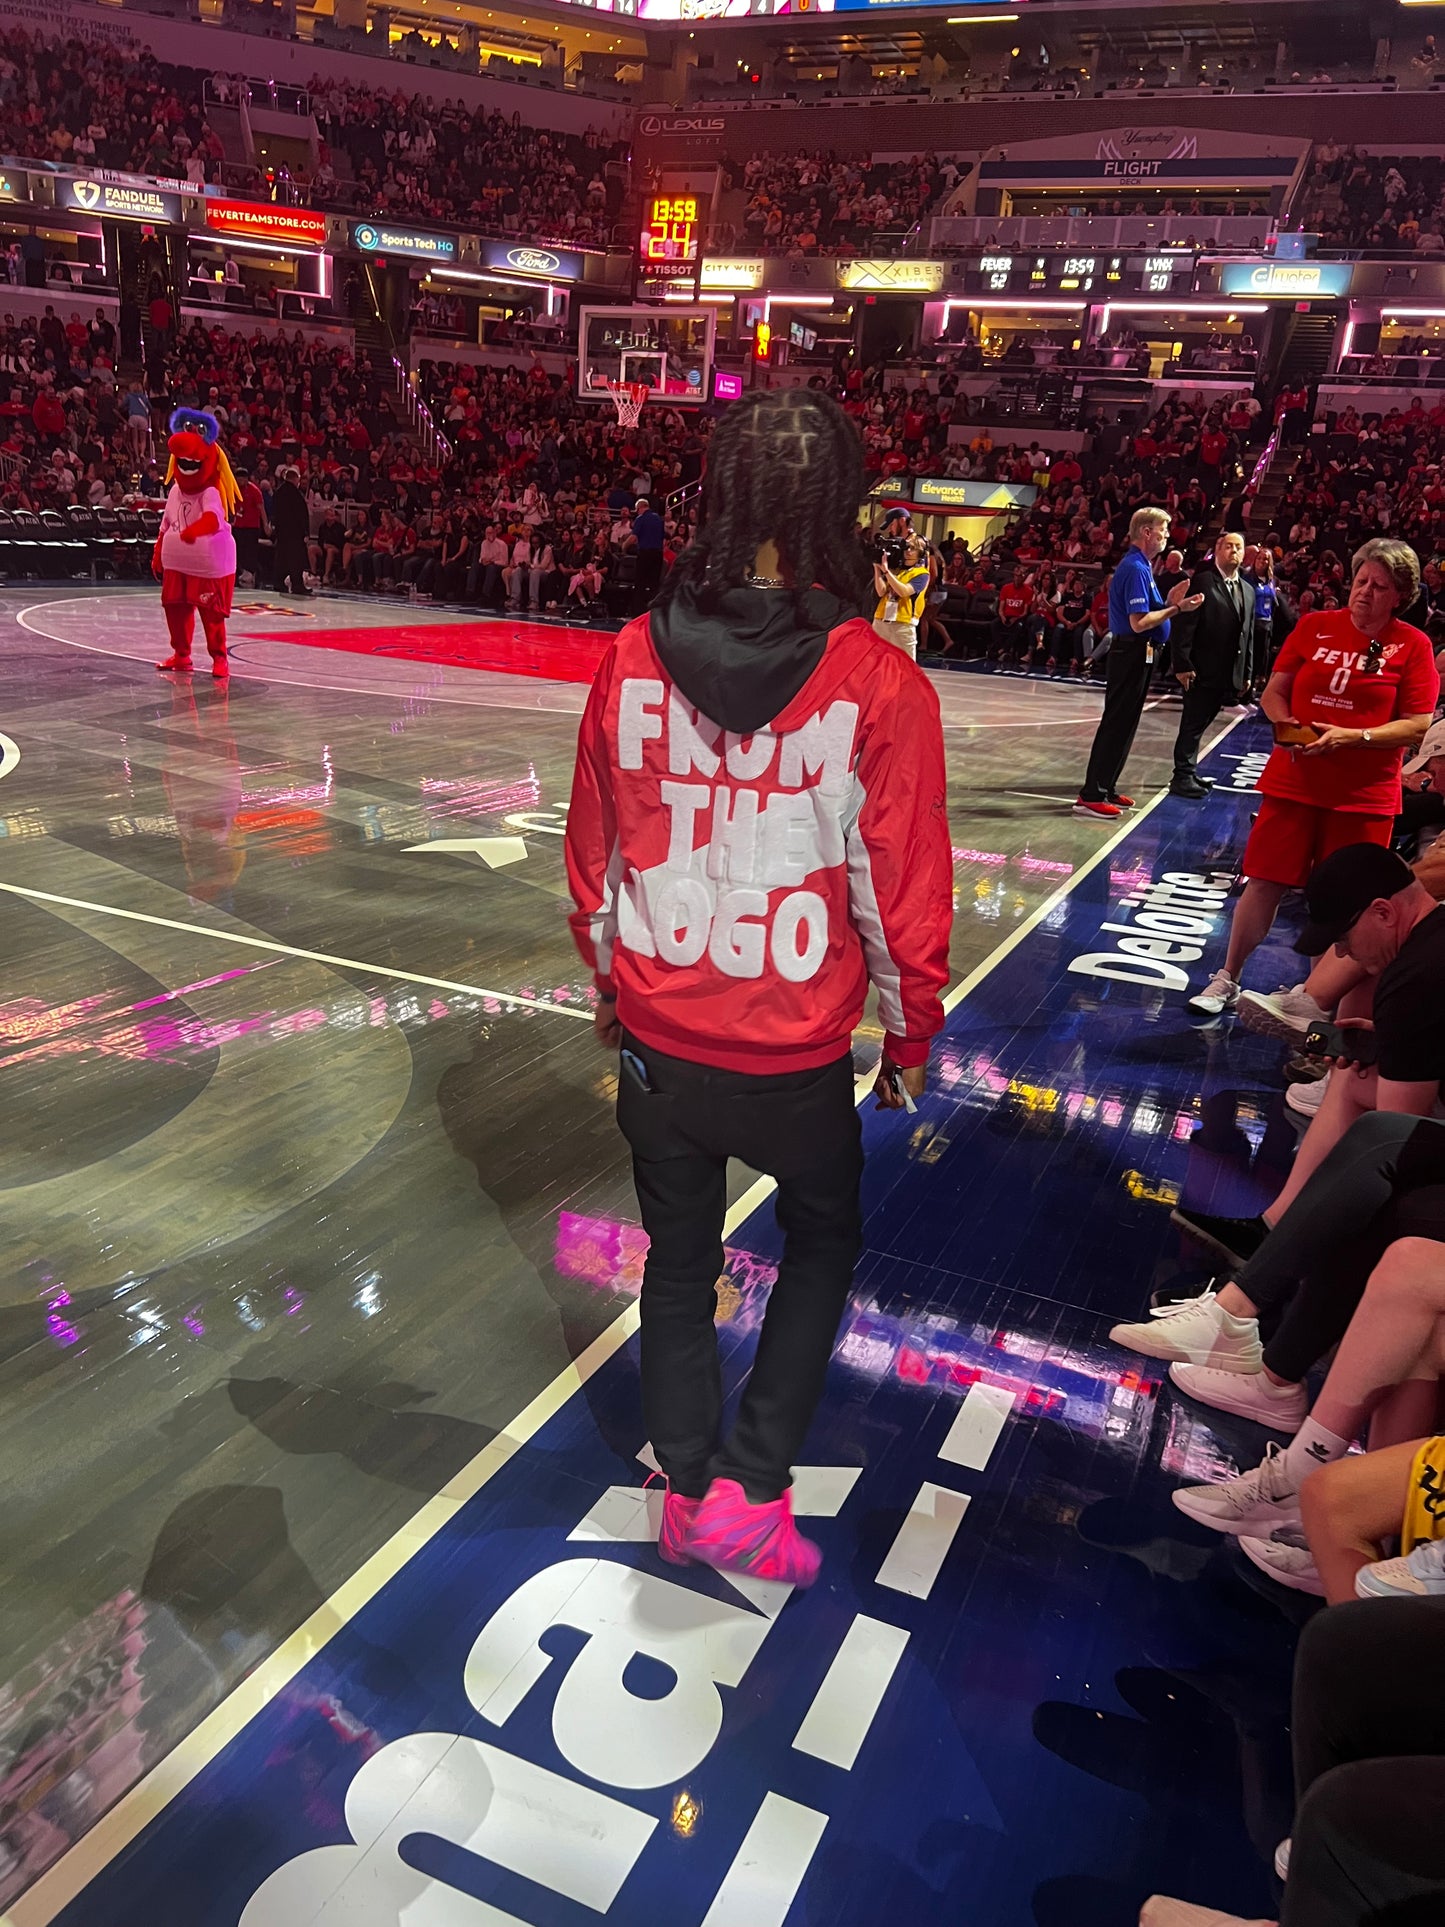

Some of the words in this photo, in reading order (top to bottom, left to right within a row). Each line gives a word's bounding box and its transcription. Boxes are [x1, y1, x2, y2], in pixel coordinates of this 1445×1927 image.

[663, 119, 725, 130] LEXUS
[1104, 162, 1161, 175] FLIGHT
[105, 188, 164, 206] FANDUEL
[106, 200, 132, 210] SPORTS
[132, 203, 164, 214] NETWORK
[653, 200, 696, 221] 13:59
[207, 208, 325, 230] FEVERTEAMSTORE.COM
[381, 233, 413, 247] Sports
[414, 237, 436, 250] Tech
[438, 241, 454, 252] HQ
[649, 222, 691, 258] 24
[516, 250, 550, 269] Ford
[980, 257, 1012, 271] FEVER
[1063, 258, 1095, 274] 13:59
[1145, 257, 1173, 271] LYNX
[654, 265, 693, 275] TISSOT
[893, 266, 943, 277] XIBER
[990, 273, 1008, 288] 52
[1149, 274, 1168, 290] 50
[685, 387, 702, 395] AT&T
[921, 483, 965, 496] Elevance
[941, 494, 965, 503] Health
[1329, 667, 1351, 695] 0
[618, 678, 859, 796] FROM
[660, 779, 815, 888] THE
[617, 867, 829, 983] LOGO
